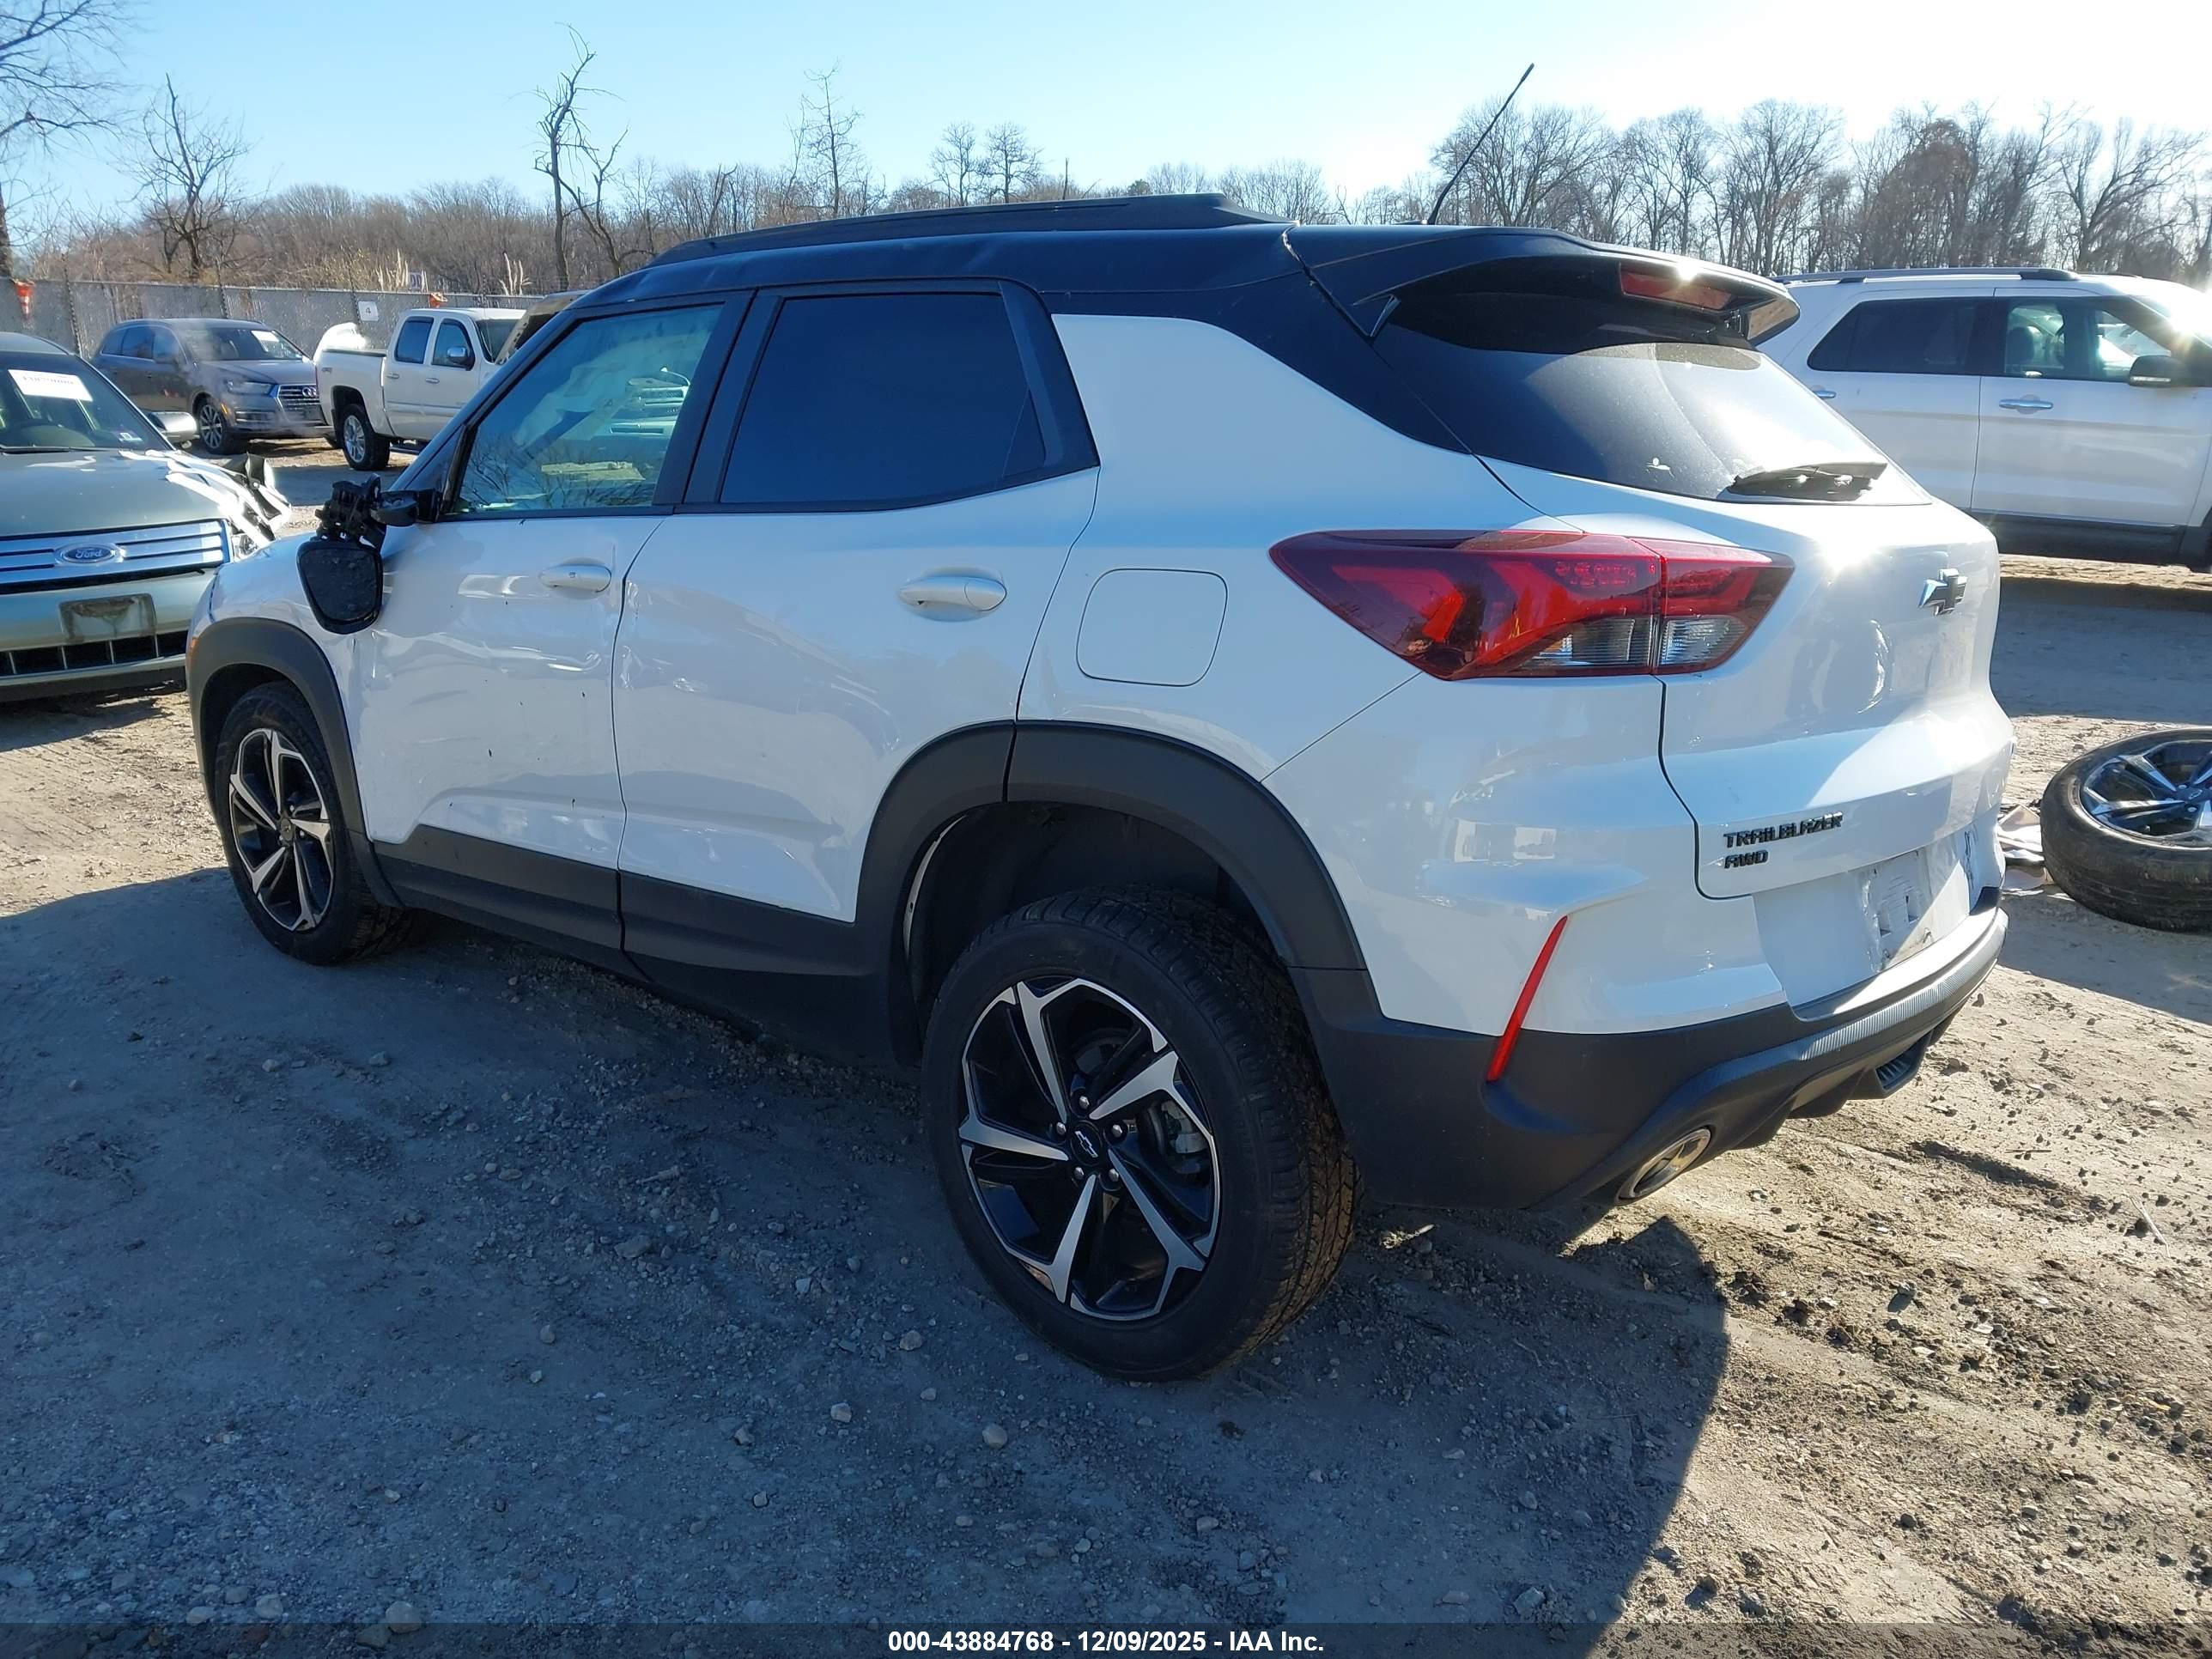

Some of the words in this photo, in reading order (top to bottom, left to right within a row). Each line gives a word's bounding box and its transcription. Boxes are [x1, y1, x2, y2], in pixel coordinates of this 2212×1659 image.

[75, 549, 103, 559] Ford
[1723, 811, 1844, 848] TRAILBLAZER
[1724, 850, 1769, 869] AWD
